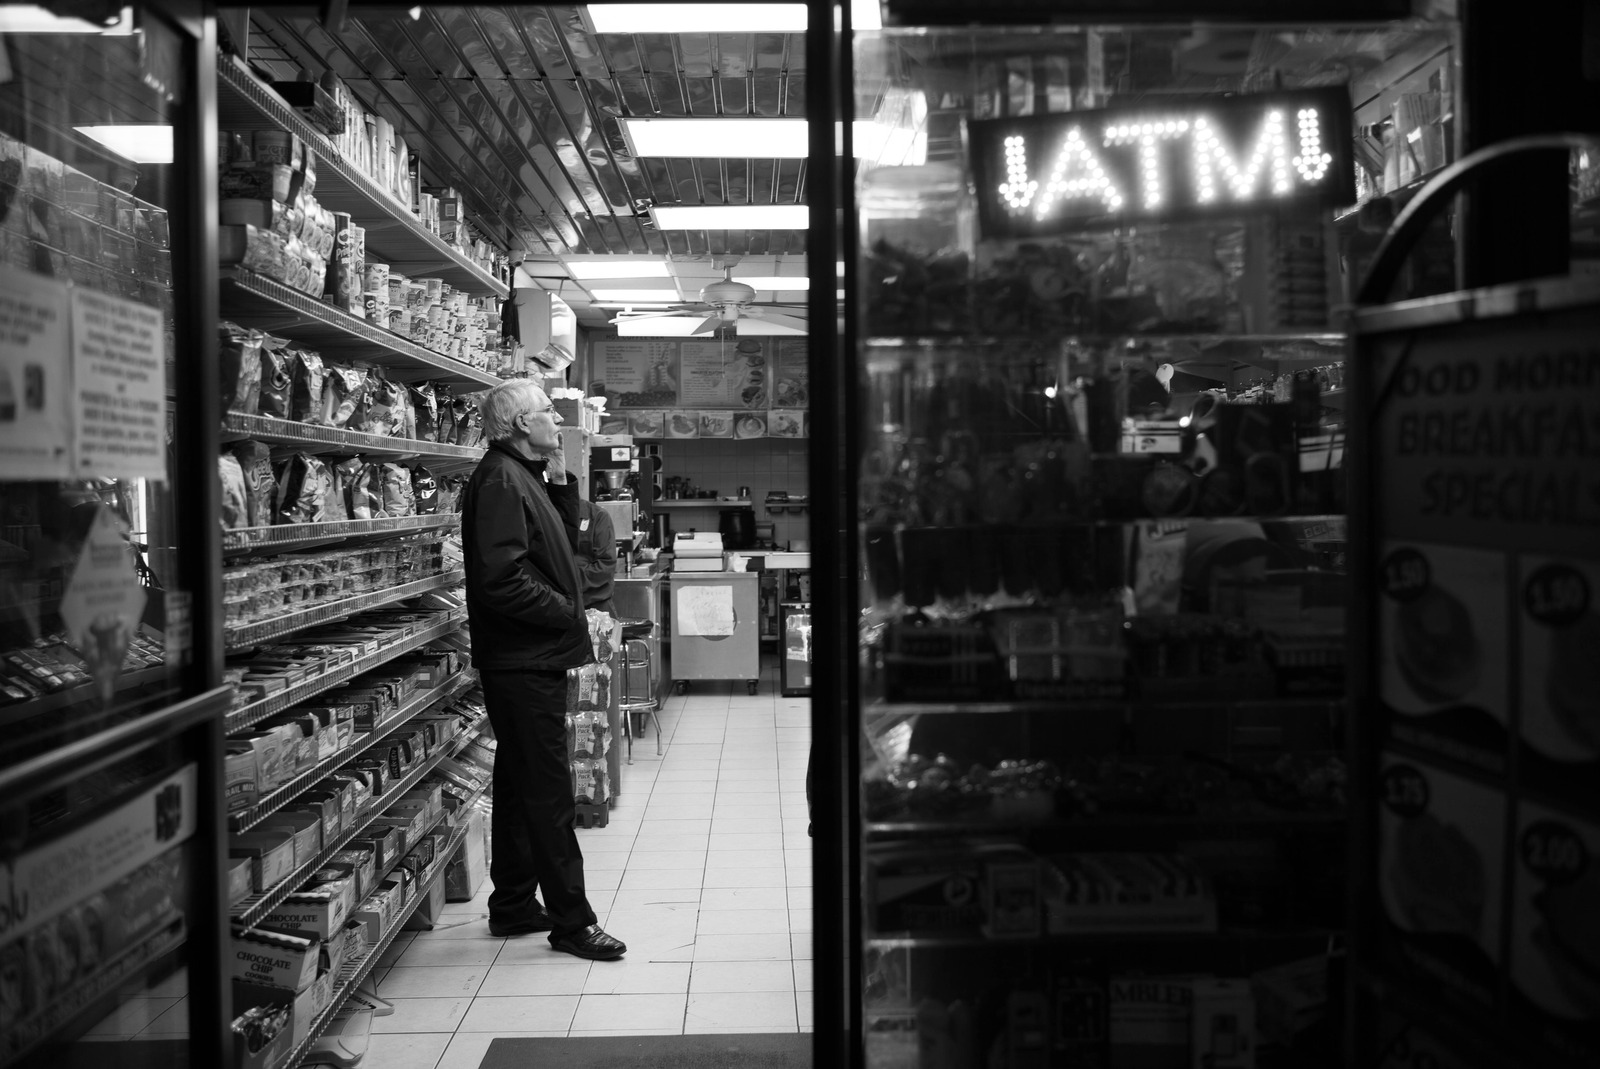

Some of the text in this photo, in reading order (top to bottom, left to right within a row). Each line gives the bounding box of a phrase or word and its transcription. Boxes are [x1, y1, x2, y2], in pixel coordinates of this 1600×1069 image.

[1035, 110, 1290, 220] ATM
[1396, 361, 1482, 397] OOD
[224, 786, 241, 798] RAIL
[265, 914, 318, 922] CHOCOLATE
[236, 951, 292, 970] CHOCOLATE
[250, 962, 274, 974] CHIP
[244, 971, 275, 982] COOKIES
